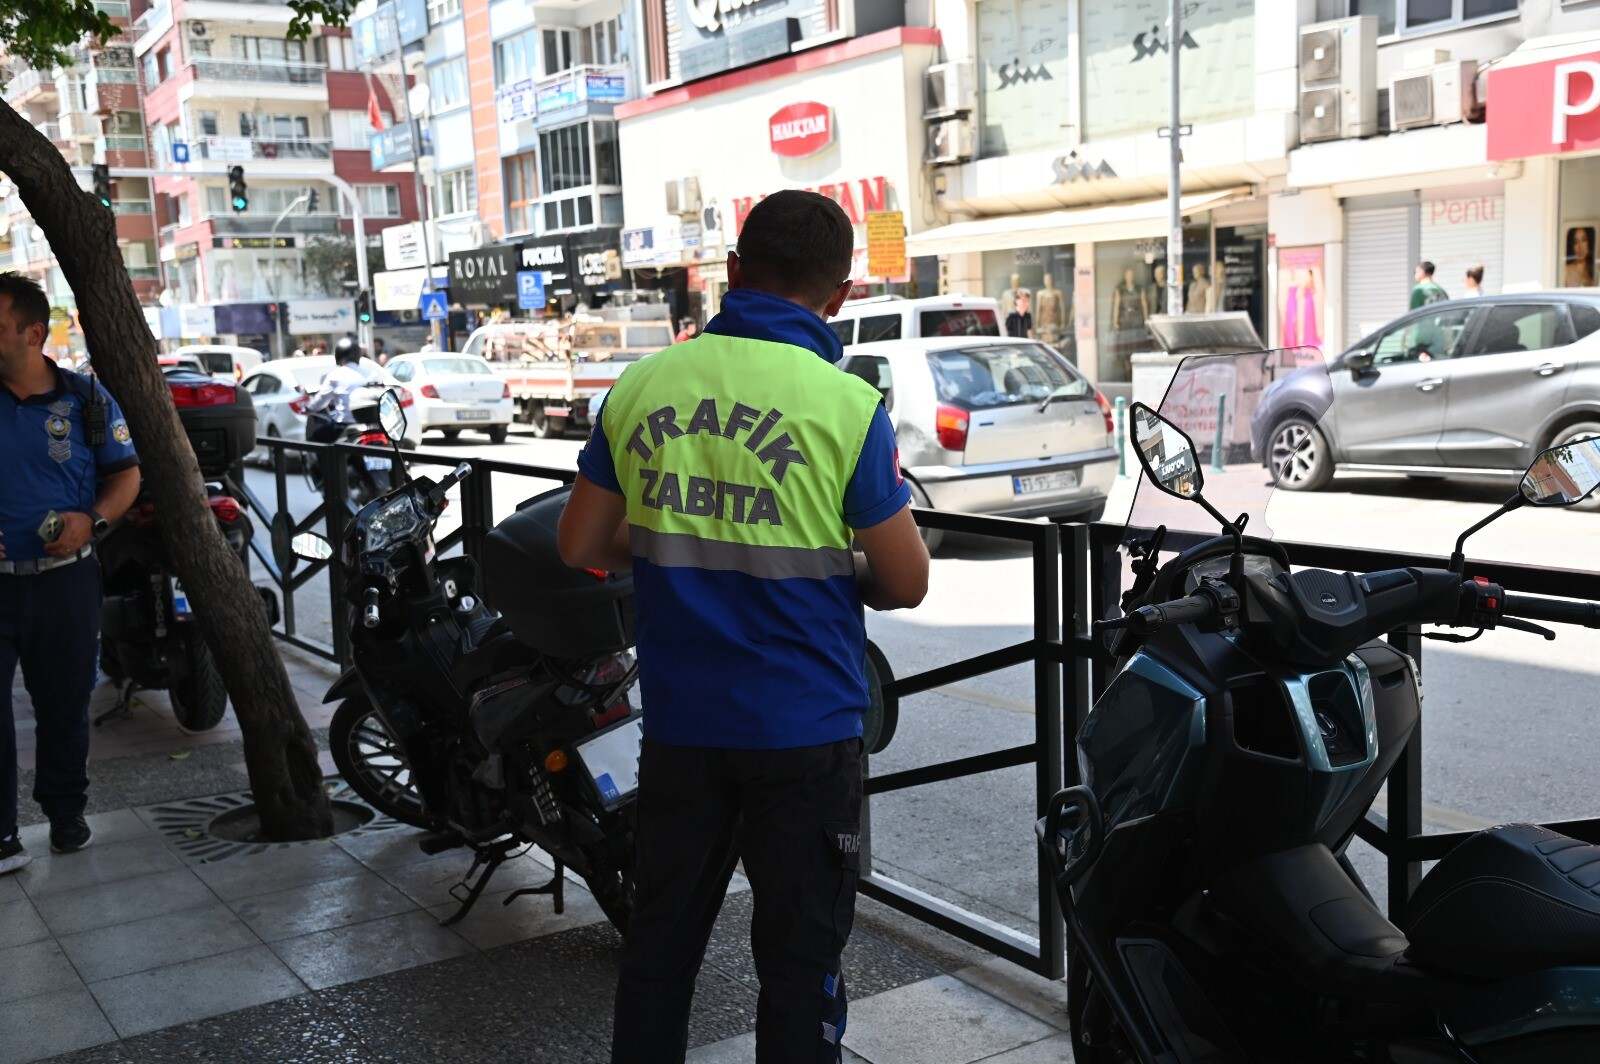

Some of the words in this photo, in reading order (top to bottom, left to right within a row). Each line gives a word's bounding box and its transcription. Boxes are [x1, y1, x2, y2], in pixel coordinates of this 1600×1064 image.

[454, 254, 508, 279] ROYAL
[626, 398, 808, 486] TRAFİK
[638, 468, 783, 526] ZABITA
[604, 788, 617, 800] TR
